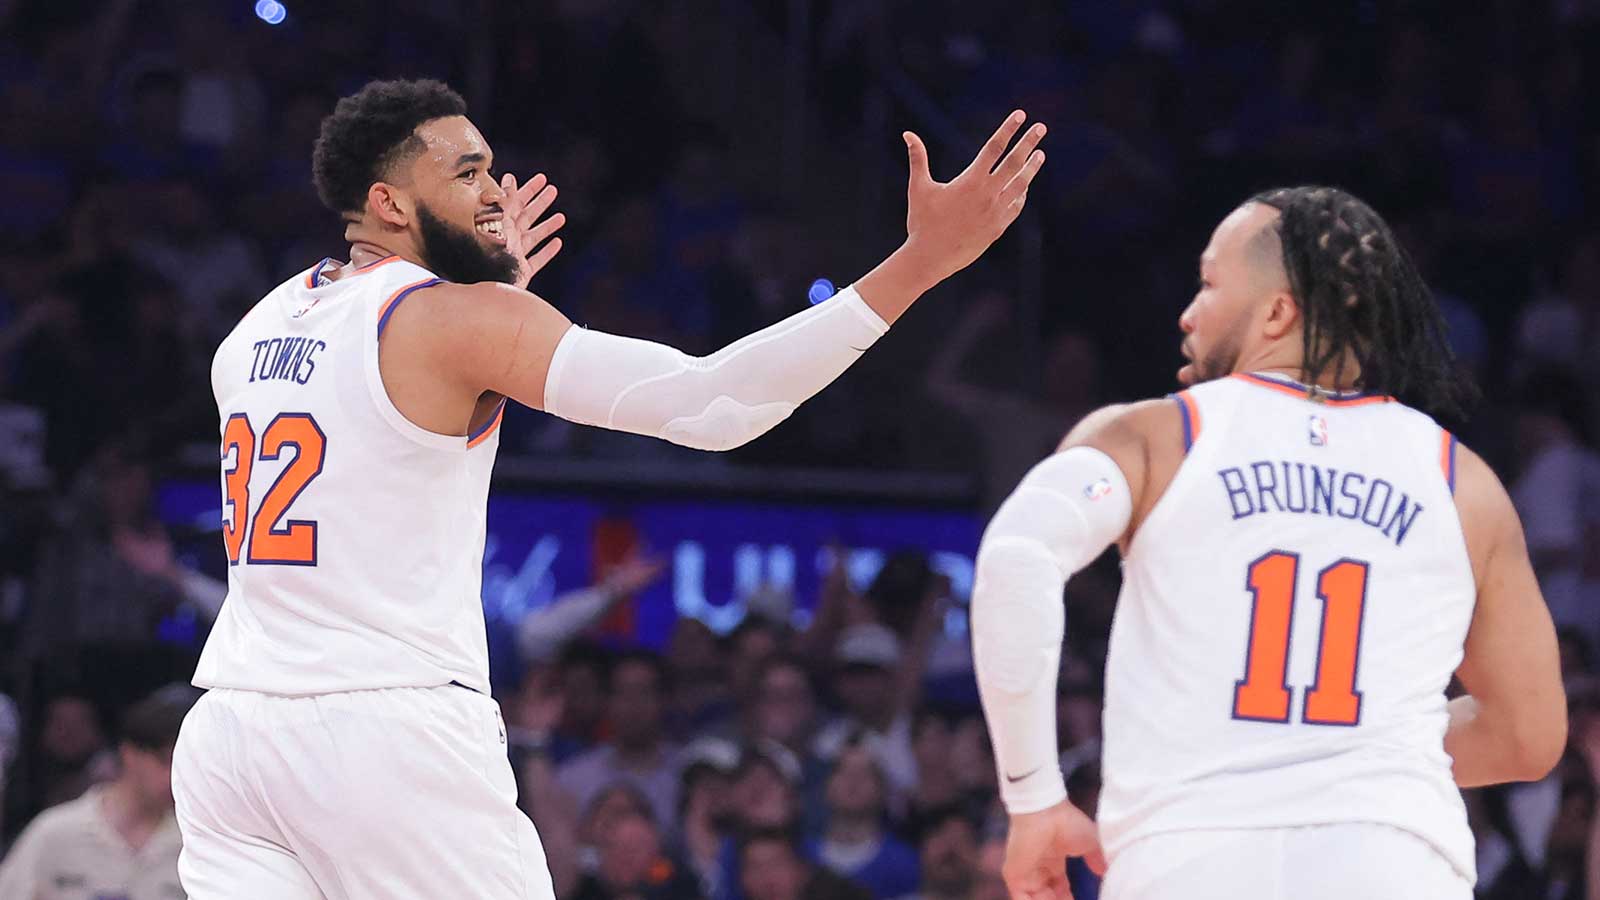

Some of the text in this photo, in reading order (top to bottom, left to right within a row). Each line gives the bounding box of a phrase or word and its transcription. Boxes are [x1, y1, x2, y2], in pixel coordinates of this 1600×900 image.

[248, 337, 326, 385] TOWNS
[222, 412, 327, 567] 32
[1217, 460, 1424, 547] BRUNSON
[1232, 549, 1370, 727] 11
